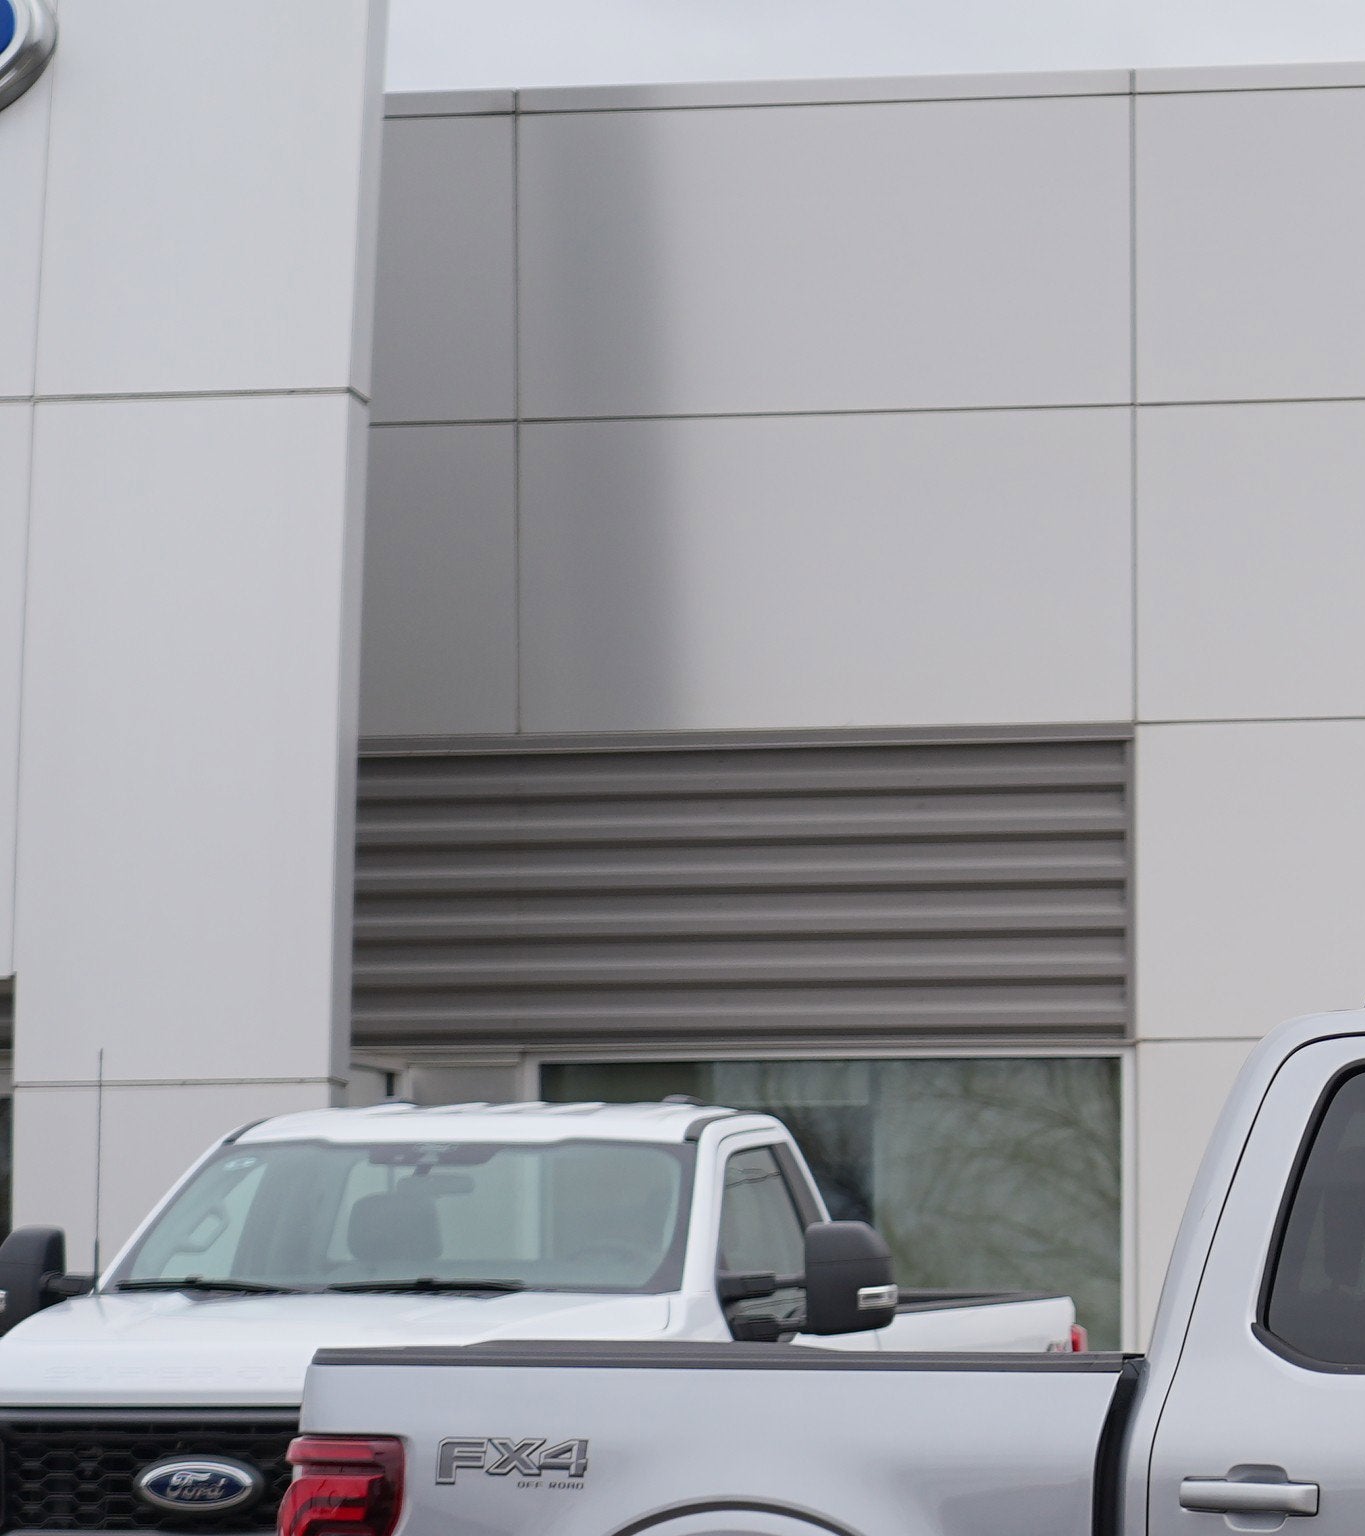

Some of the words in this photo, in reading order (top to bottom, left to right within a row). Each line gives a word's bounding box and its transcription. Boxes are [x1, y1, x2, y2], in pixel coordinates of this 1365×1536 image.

[435, 1436, 590, 1485] FX4
[165, 1470, 228, 1499] Ford
[516, 1480, 544, 1489] OFF
[548, 1480, 585, 1490] ROAD
